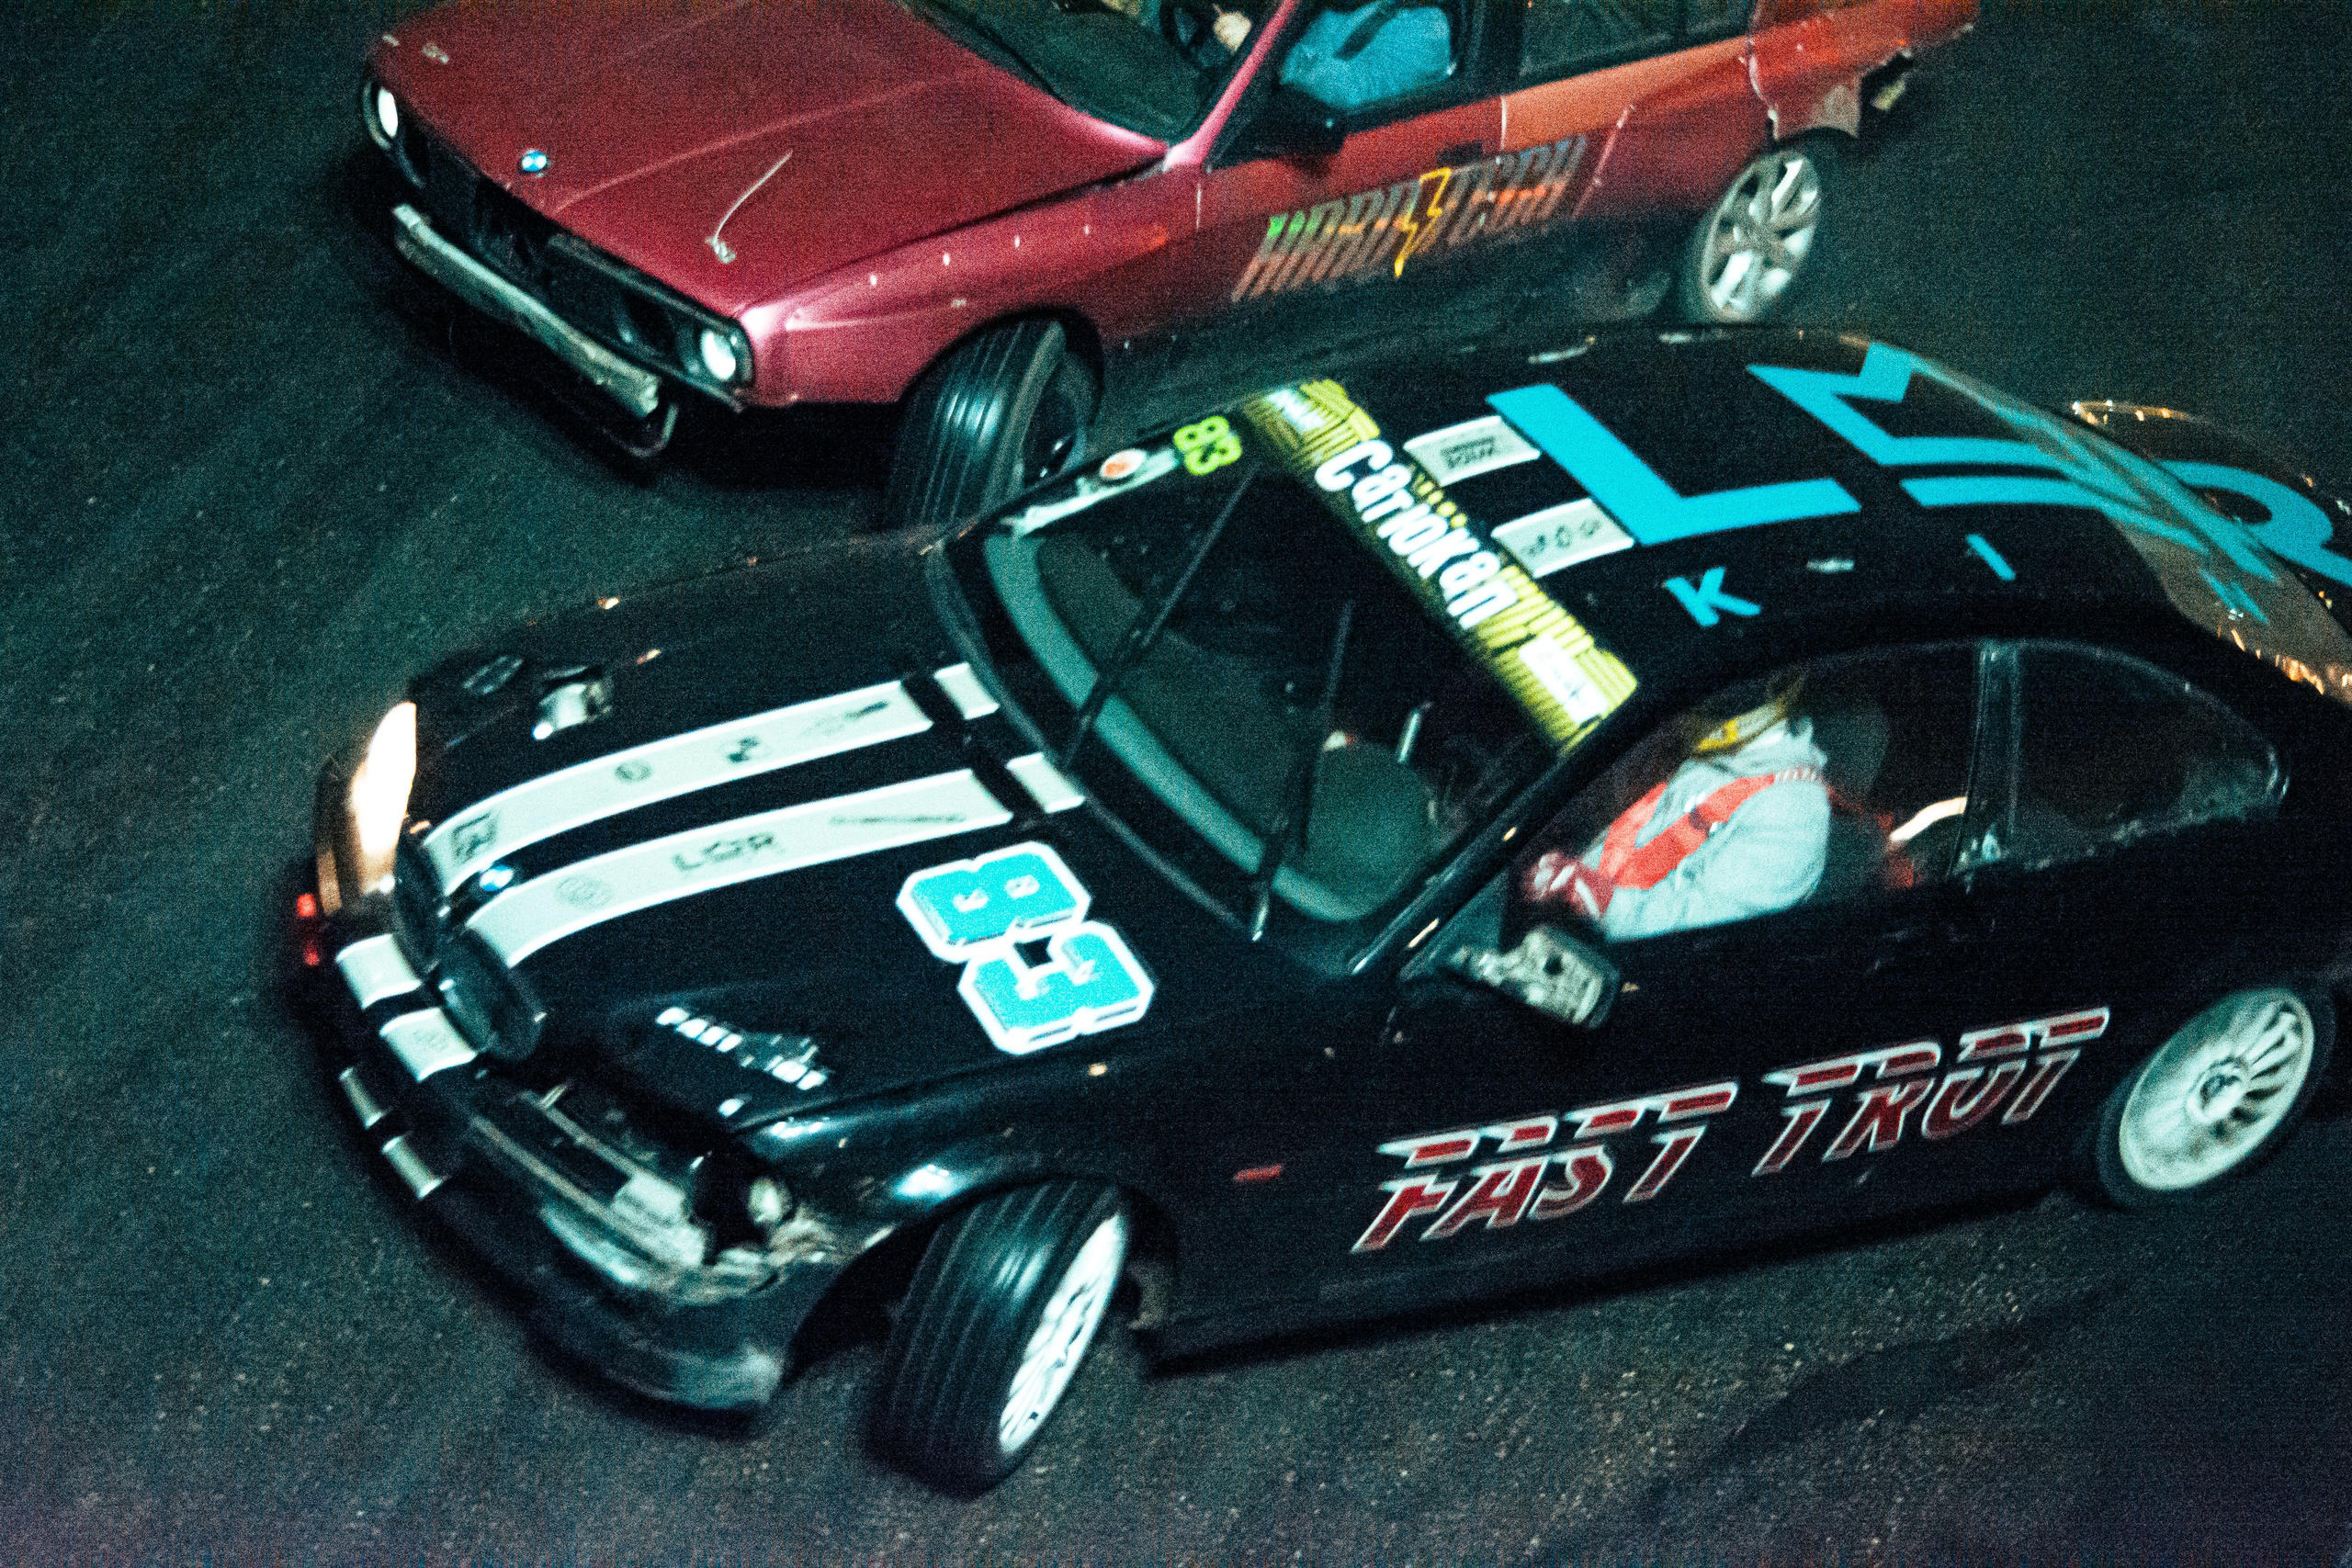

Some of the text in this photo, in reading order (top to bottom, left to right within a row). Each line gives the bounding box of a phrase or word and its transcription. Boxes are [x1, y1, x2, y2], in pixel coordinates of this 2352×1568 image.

[895, 840, 1156, 1055] 83
[1350, 1005, 2112, 1254] FAST TROT
